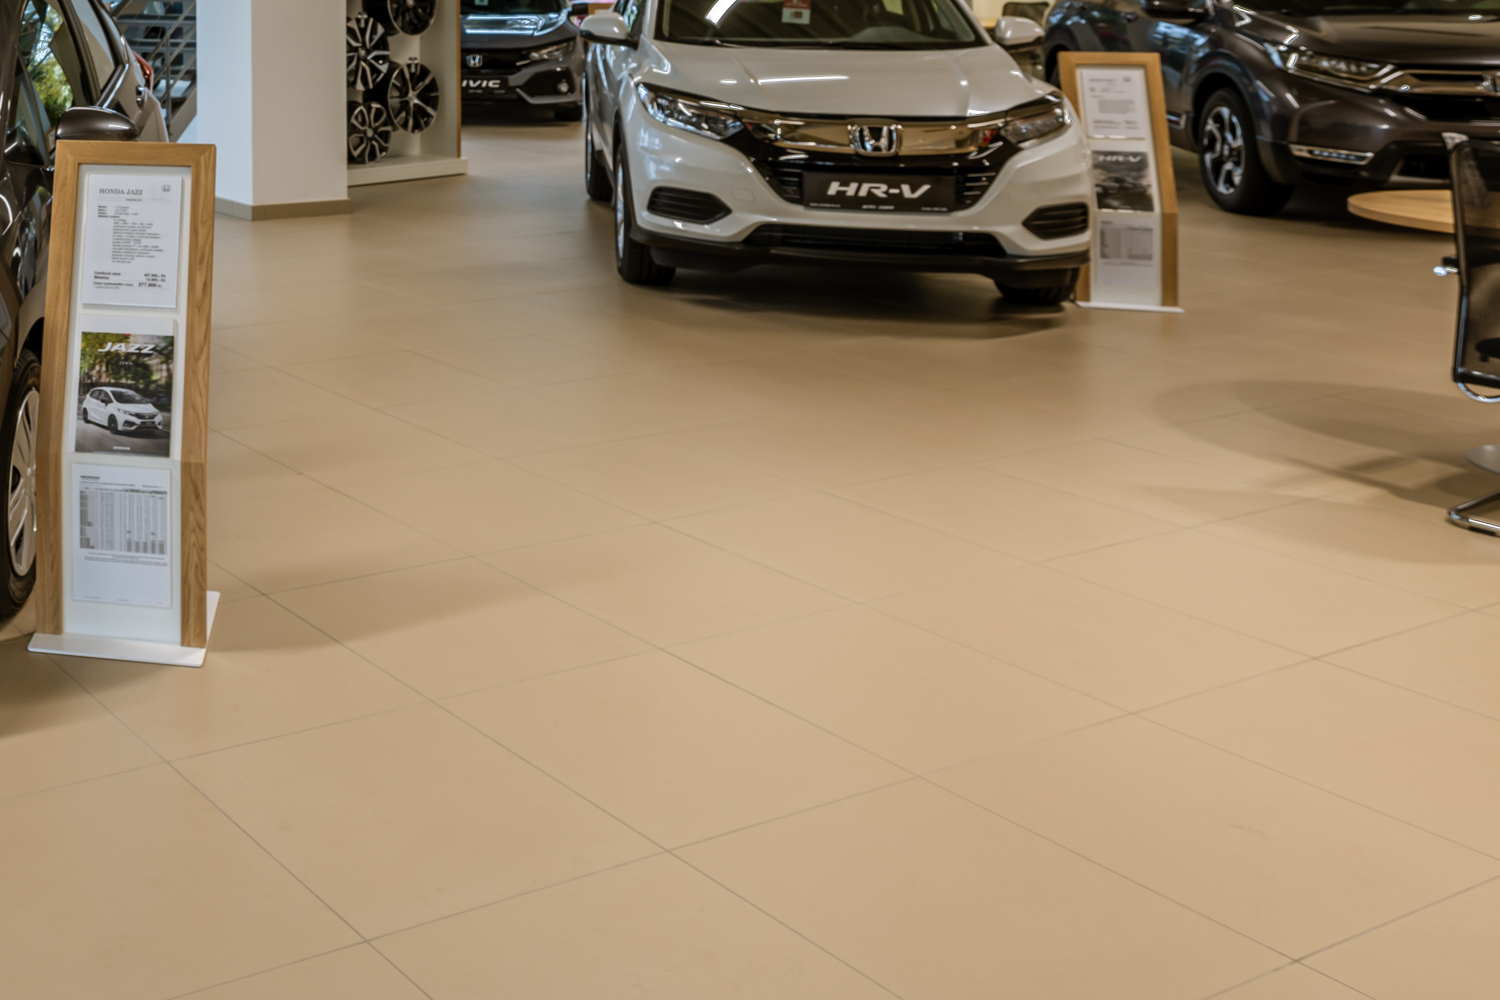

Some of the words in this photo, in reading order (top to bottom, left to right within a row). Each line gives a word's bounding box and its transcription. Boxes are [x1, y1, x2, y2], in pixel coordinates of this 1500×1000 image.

[462, 80, 501, 88] IVIC
[826, 181, 932, 199] HR-V
[97, 342, 156, 354] JAZZ
